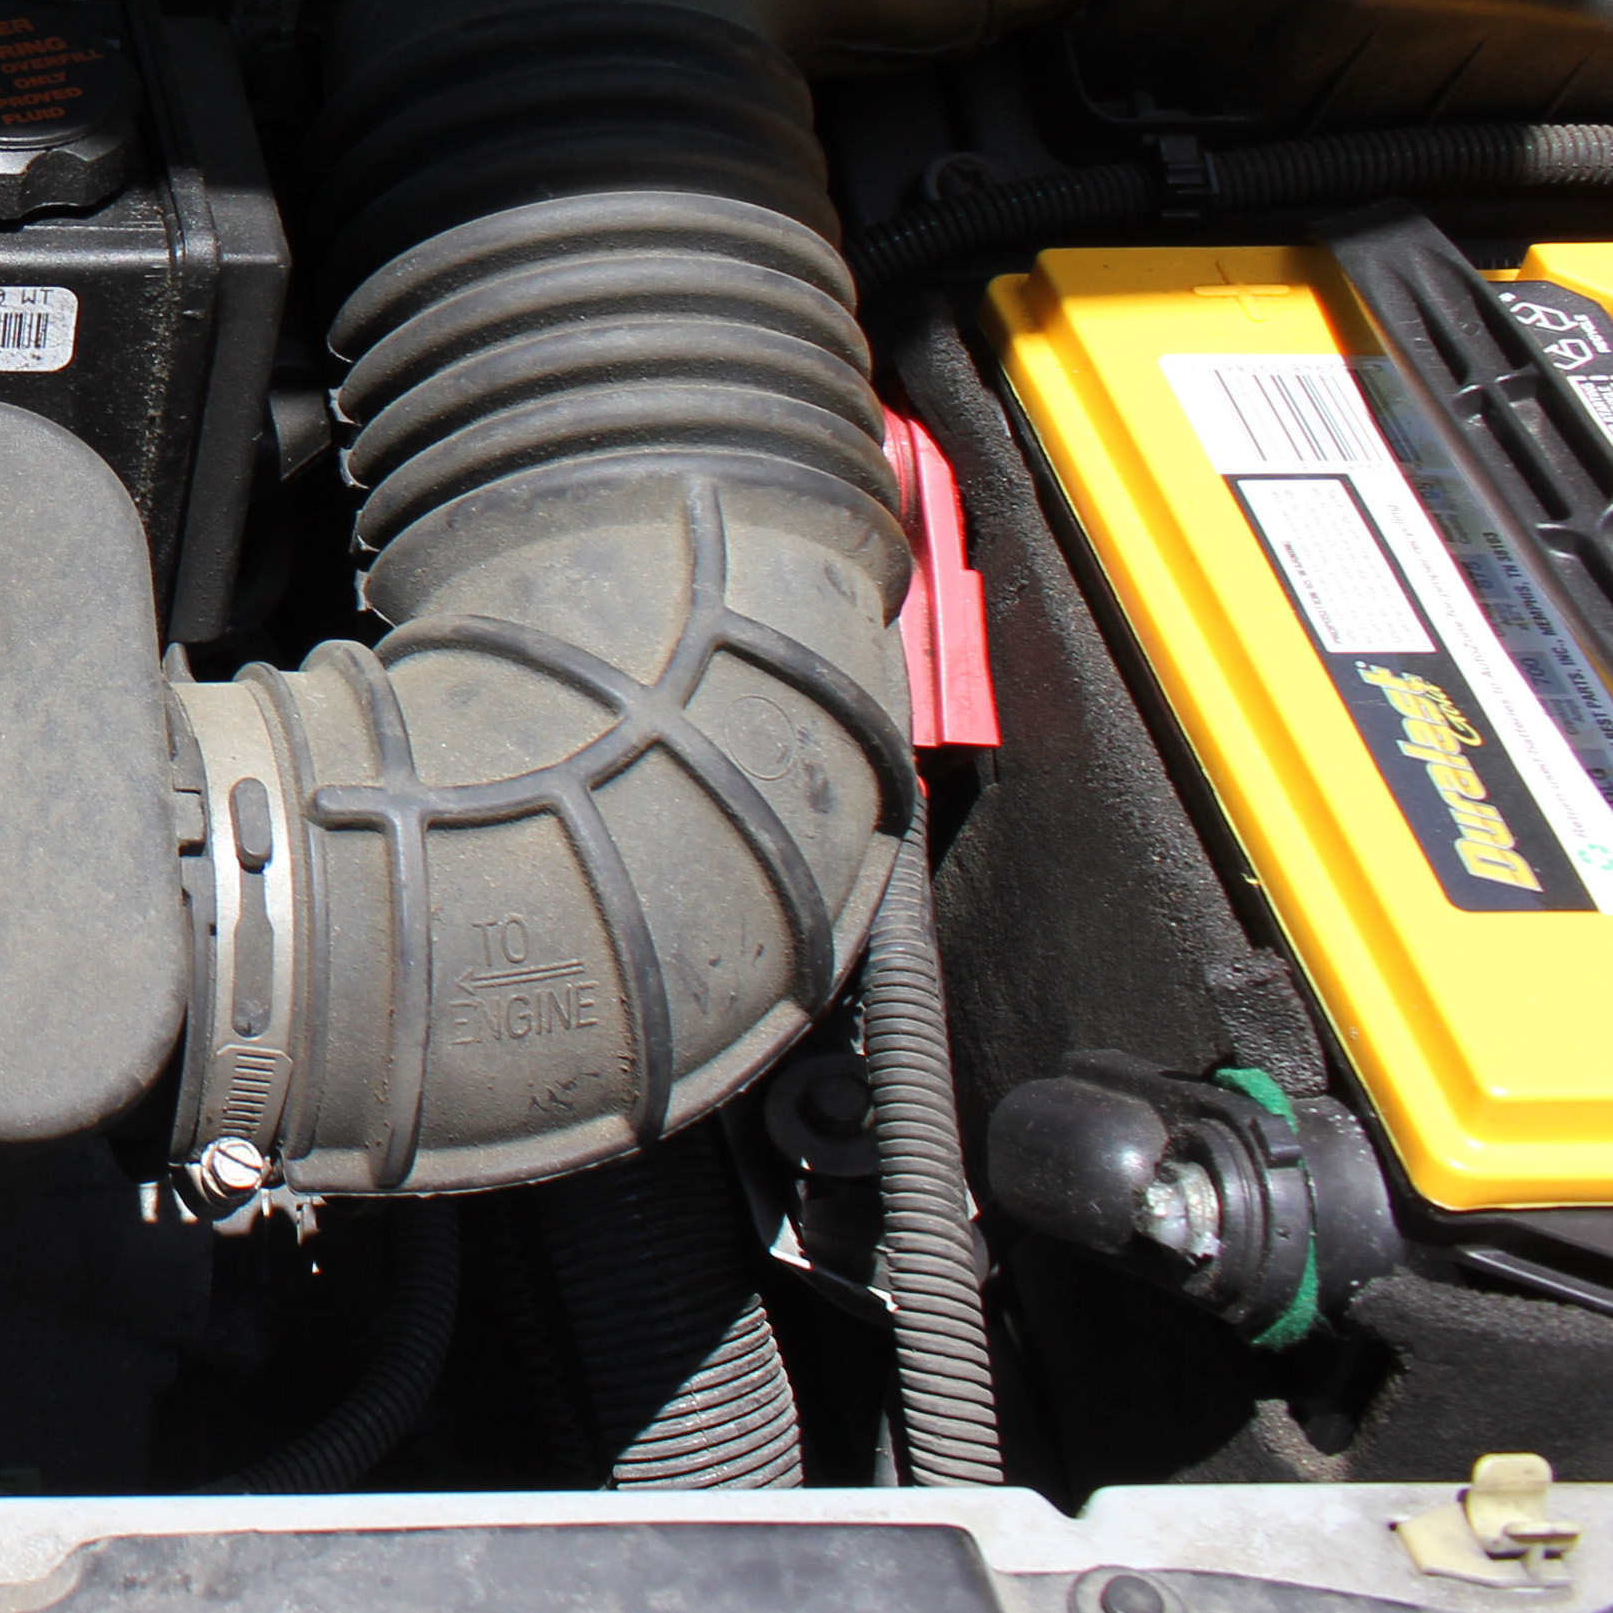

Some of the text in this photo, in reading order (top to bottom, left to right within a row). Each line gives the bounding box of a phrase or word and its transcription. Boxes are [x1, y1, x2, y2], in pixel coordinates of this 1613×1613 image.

[1, 48, 105, 74] OVERFILL
[13, 71, 68, 90] ONLY
[1, 106, 66, 126] FLUID
[21, 289, 53, 305] WT
[1482, 530, 1513, 564] 38103
[1281, 540, 1344, 645] PROPOSITION 65 WARNING
[1502, 563, 1523, 580] TN
[1514, 580, 1559, 637] MEMPHIS,
[1455, 621, 1492, 678] AutoZone
[1518, 657, 1552, 684] 700
[1425, 680, 1483, 746] Gold
[1574, 669, 1605, 714] PARTS,
[1502, 699, 1541, 760] batteries
[1356, 664, 1544, 893] Duralast
[1539, 760, 1559, 790] used
[1557, 790, 1588, 838] Return
[471, 911, 528, 968] TO
[447, 980, 600, 1046] ENGINE
